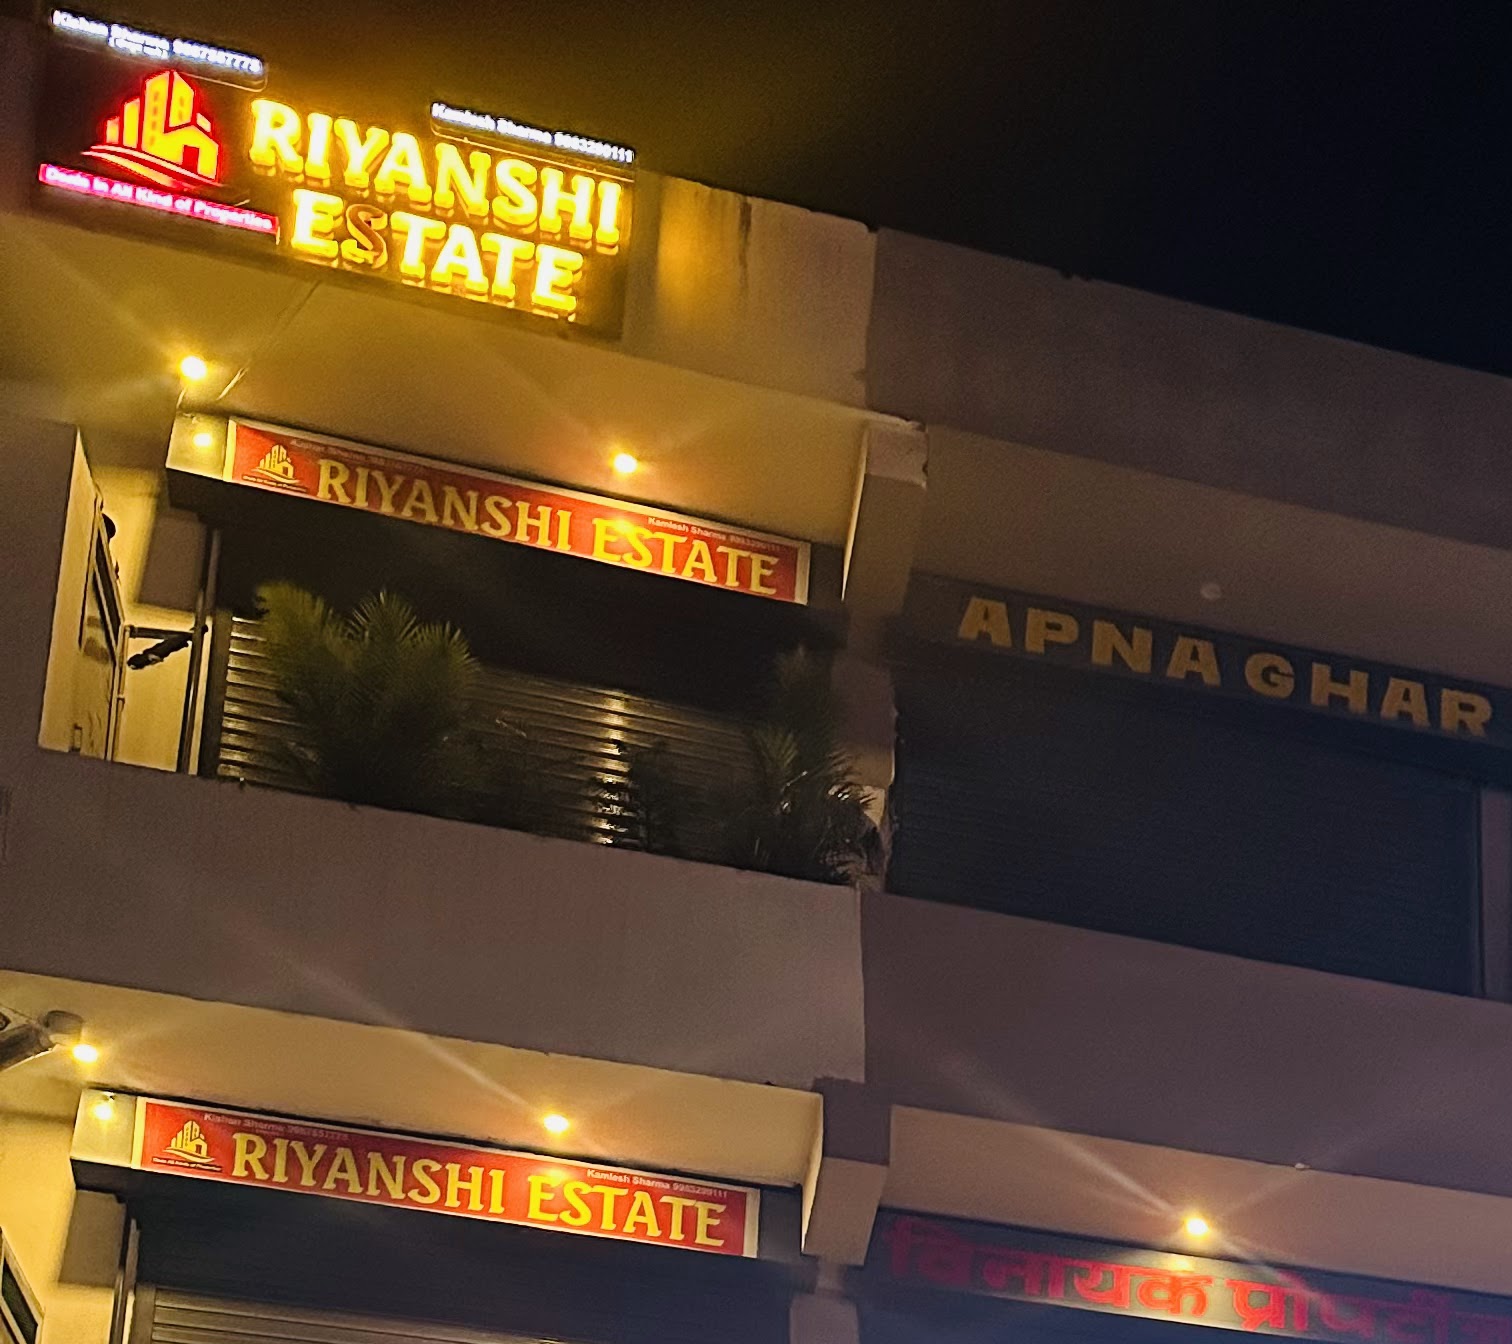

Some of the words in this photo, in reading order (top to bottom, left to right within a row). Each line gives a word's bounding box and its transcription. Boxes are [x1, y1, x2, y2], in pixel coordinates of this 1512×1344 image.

[249, 98, 622, 246] RIYANSHI
[290, 188, 584, 313] ESTATE
[316, 458, 573, 551] RIYANSHI
[592, 517, 780, 596] ESTATE
[957, 595, 1222, 687] APNA
[1244, 651, 1494, 737] GHAR
[231, 1131, 506, 1215] RIYANSHI
[527, 1175, 727, 1248] ESTATE
[586, 1168, 630, 1184] Kamlesh
[632, 1176, 670, 1189] Sharma
[880, 1216, 1215, 1317] विनायक
